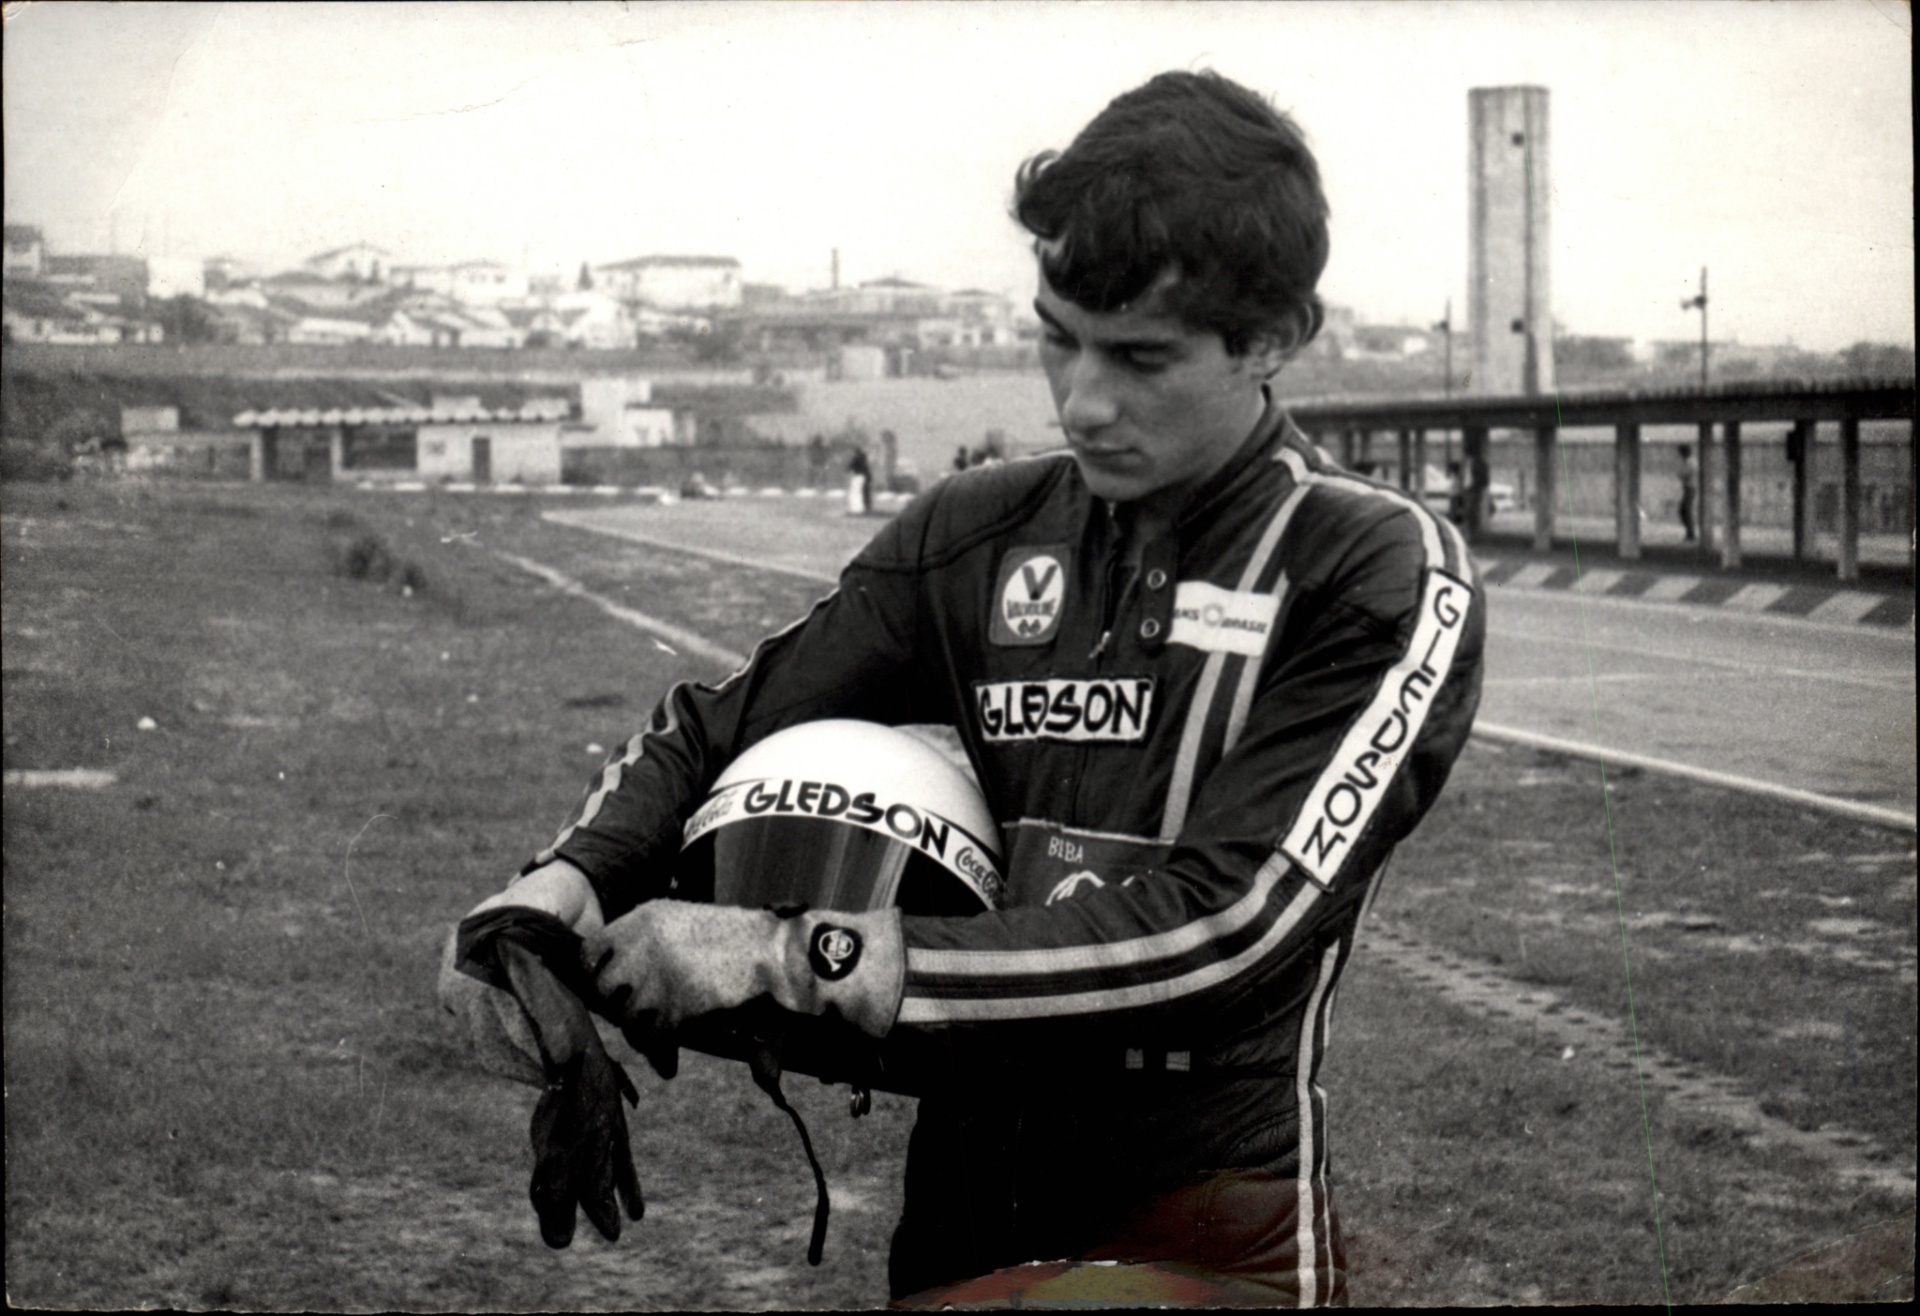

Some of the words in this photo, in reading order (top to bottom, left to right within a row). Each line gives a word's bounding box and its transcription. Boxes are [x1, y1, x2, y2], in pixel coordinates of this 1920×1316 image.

[1301, 586, 1461, 867] GLEDSON
[743, 779, 950, 859] GLEDSON
[1048, 836, 1084, 864] BIBA
